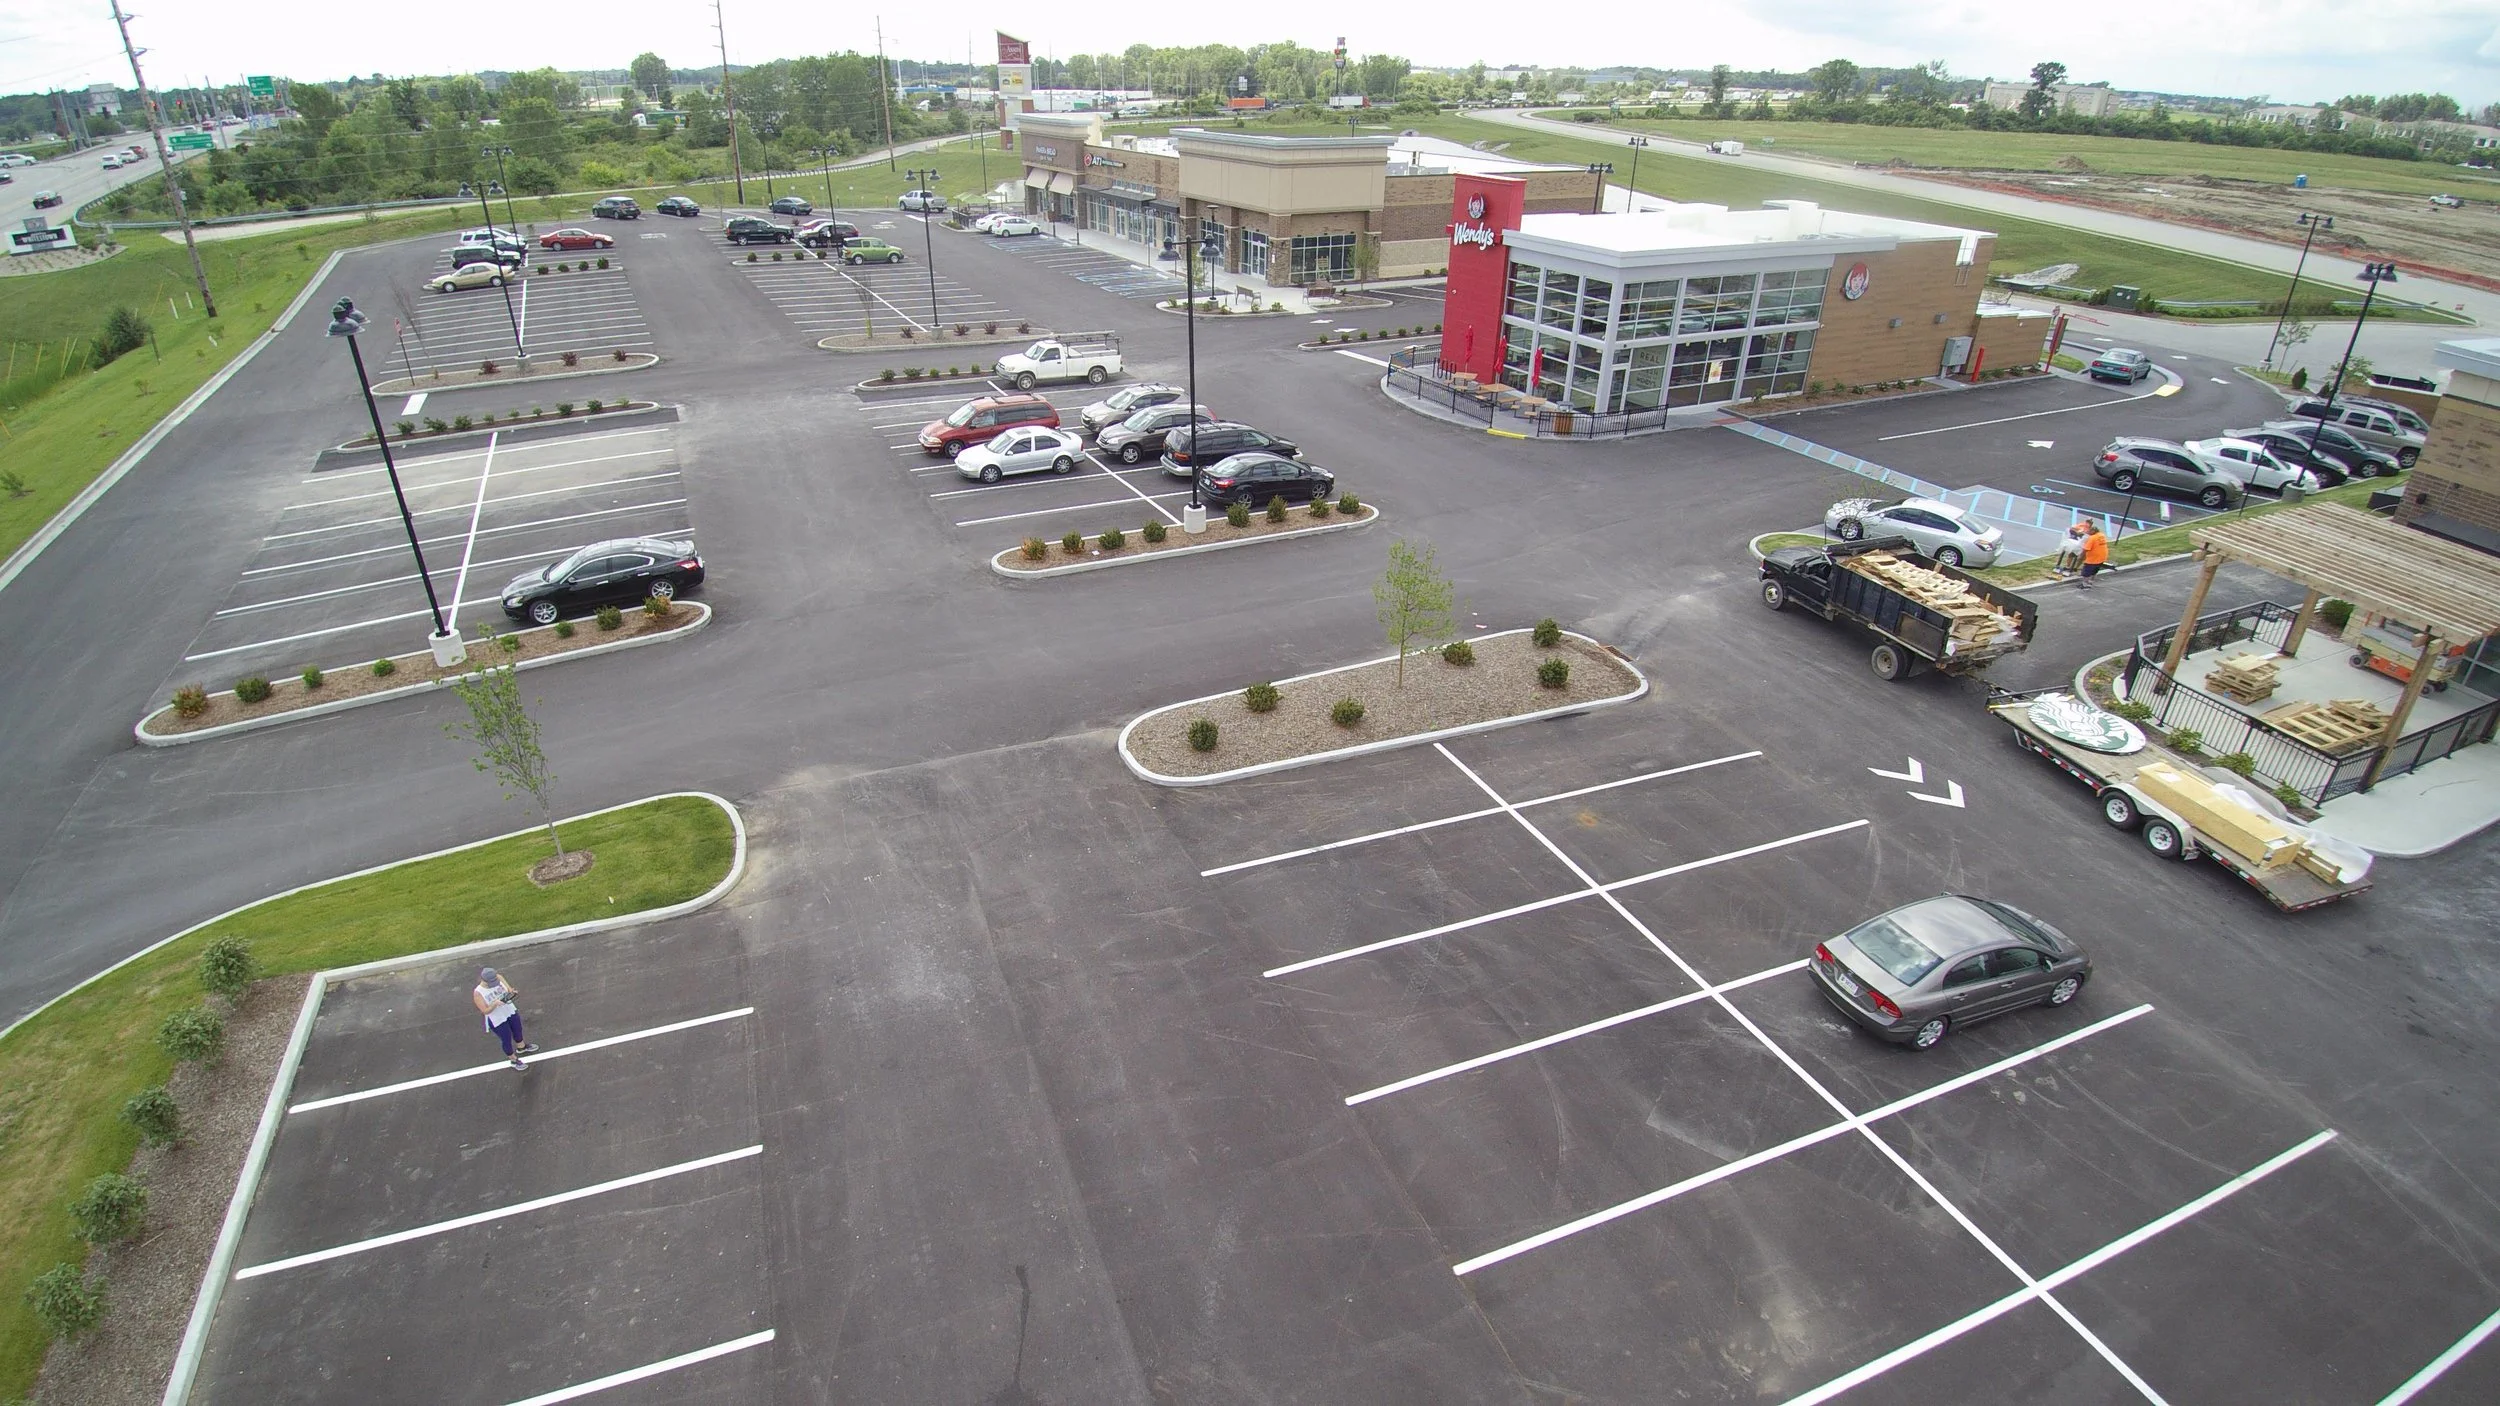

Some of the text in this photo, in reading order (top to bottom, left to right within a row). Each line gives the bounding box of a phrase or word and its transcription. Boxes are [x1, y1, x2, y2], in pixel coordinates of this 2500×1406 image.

[1091, 156, 1102, 166] ATI
[1454, 222, 1494, 250] Wendy's
[1640, 351, 1660, 364] REAL
